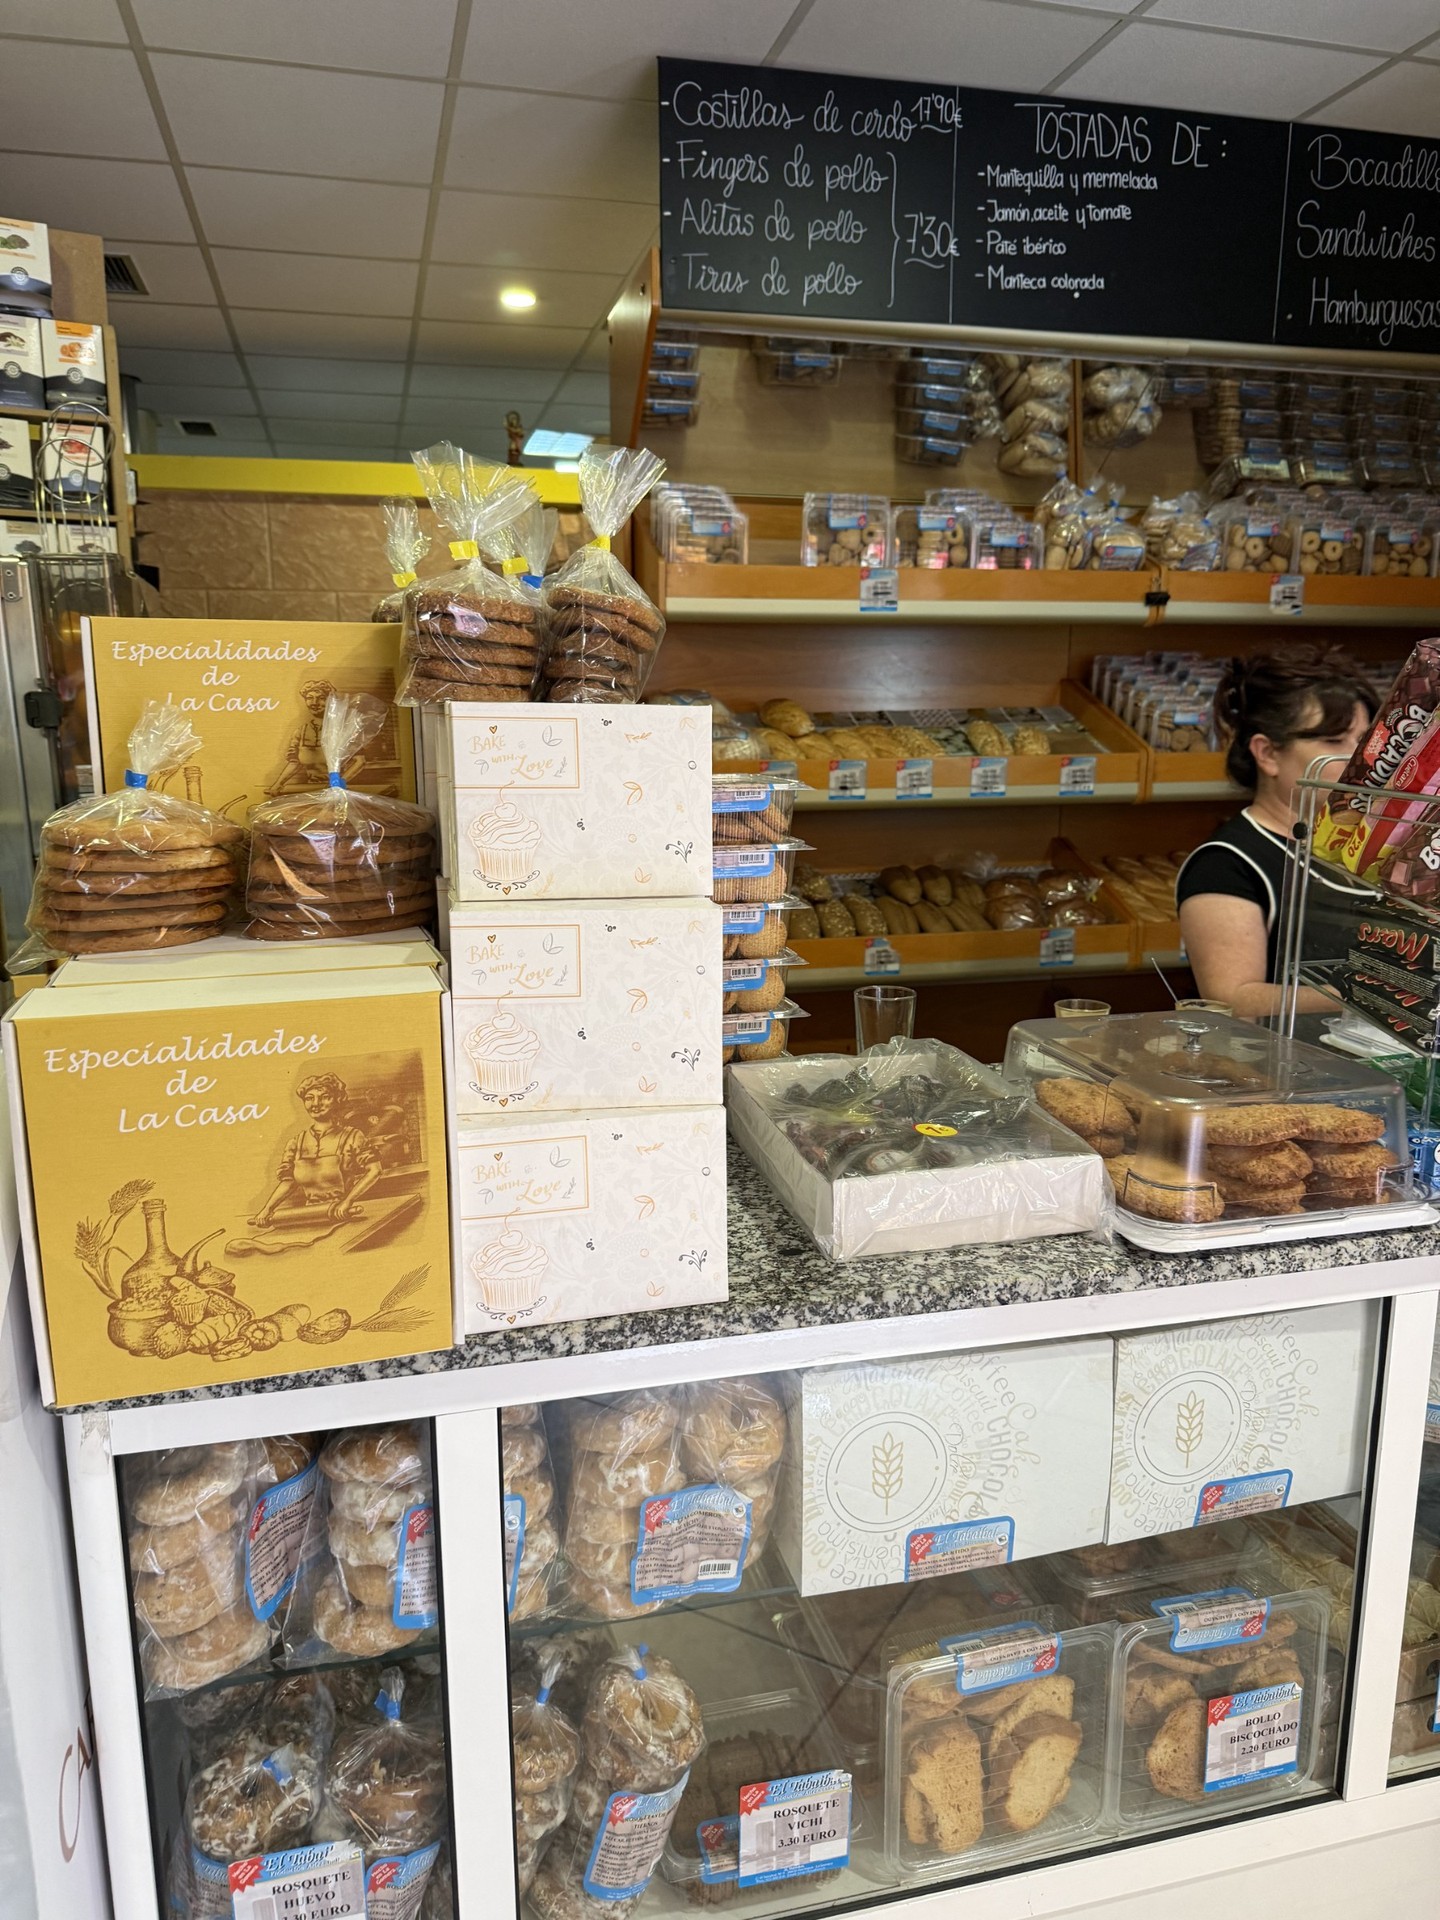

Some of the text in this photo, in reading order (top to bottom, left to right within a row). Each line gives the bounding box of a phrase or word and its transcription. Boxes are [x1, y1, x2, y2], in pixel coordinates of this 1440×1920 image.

[673, 81, 805, 129] Costillas
[813, 90, 843, 133] de
[851, 100, 917, 142] cerdo
[1014, 103, 1151, 163] TOSTADAS
[676, 140, 889, 202] Fingers de pollo
[1070, 173, 1079, 196] y
[1083, 170, 1158, 190] mermelada
[1087, 203, 1132, 221] tomate
[680, 198, 867, 250] Alitas de pollo
[1297, 200, 1436, 262] Sandwiches
[1023, 237, 1067, 255] ibérico
[682, 253, 863, 307] Tiras de pollo
[1051, 273, 1105, 290] colorada
[111, 639, 322, 666] Especialidades
[202, 665, 241, 686] de
[208, 693, 280, 712] Casa
[468, 735, 506, 755] BAKE
[491, 754, 514, 764] WITH
[1358, 922, 1430, 964] Mars
[466, 943, 504, 965] BAKE
[489, 963, 514, 974] WITH
[43, 1029, 327, 1079] Especialidades
[166, 1070, 218, 1096] de
[118, 1102, 270, 1134] La Casa
[471, 1161, 511, 1185] BAKE
[496, 1179, 520, 1191] WITH
[910, 1534, 924, 1548] Hecho
[915, 1539, 933, 1555] Gomera
[1245, 1712, 1281, 1727] BOLLO
[1230, 1721, 1298, 1744] BISCOCHADO
[1241, 1736, 1290, 1756] 2.20 EURO
[742, 1786, 757, 1801] Hecho
[747, 1790, 765, 1808] Gomera
[773, 1798, 840, 1819] ROSQUETE
[788, 1817, 823, 1831] VICHI
[778, 1829, 837, 1848] 3.30 EURO
[272, 1871, 351, 1895] ROSQUETE
[284, 1891, 336, 1909] HUEVO
[311, 1904, 351, 1920] EURO
